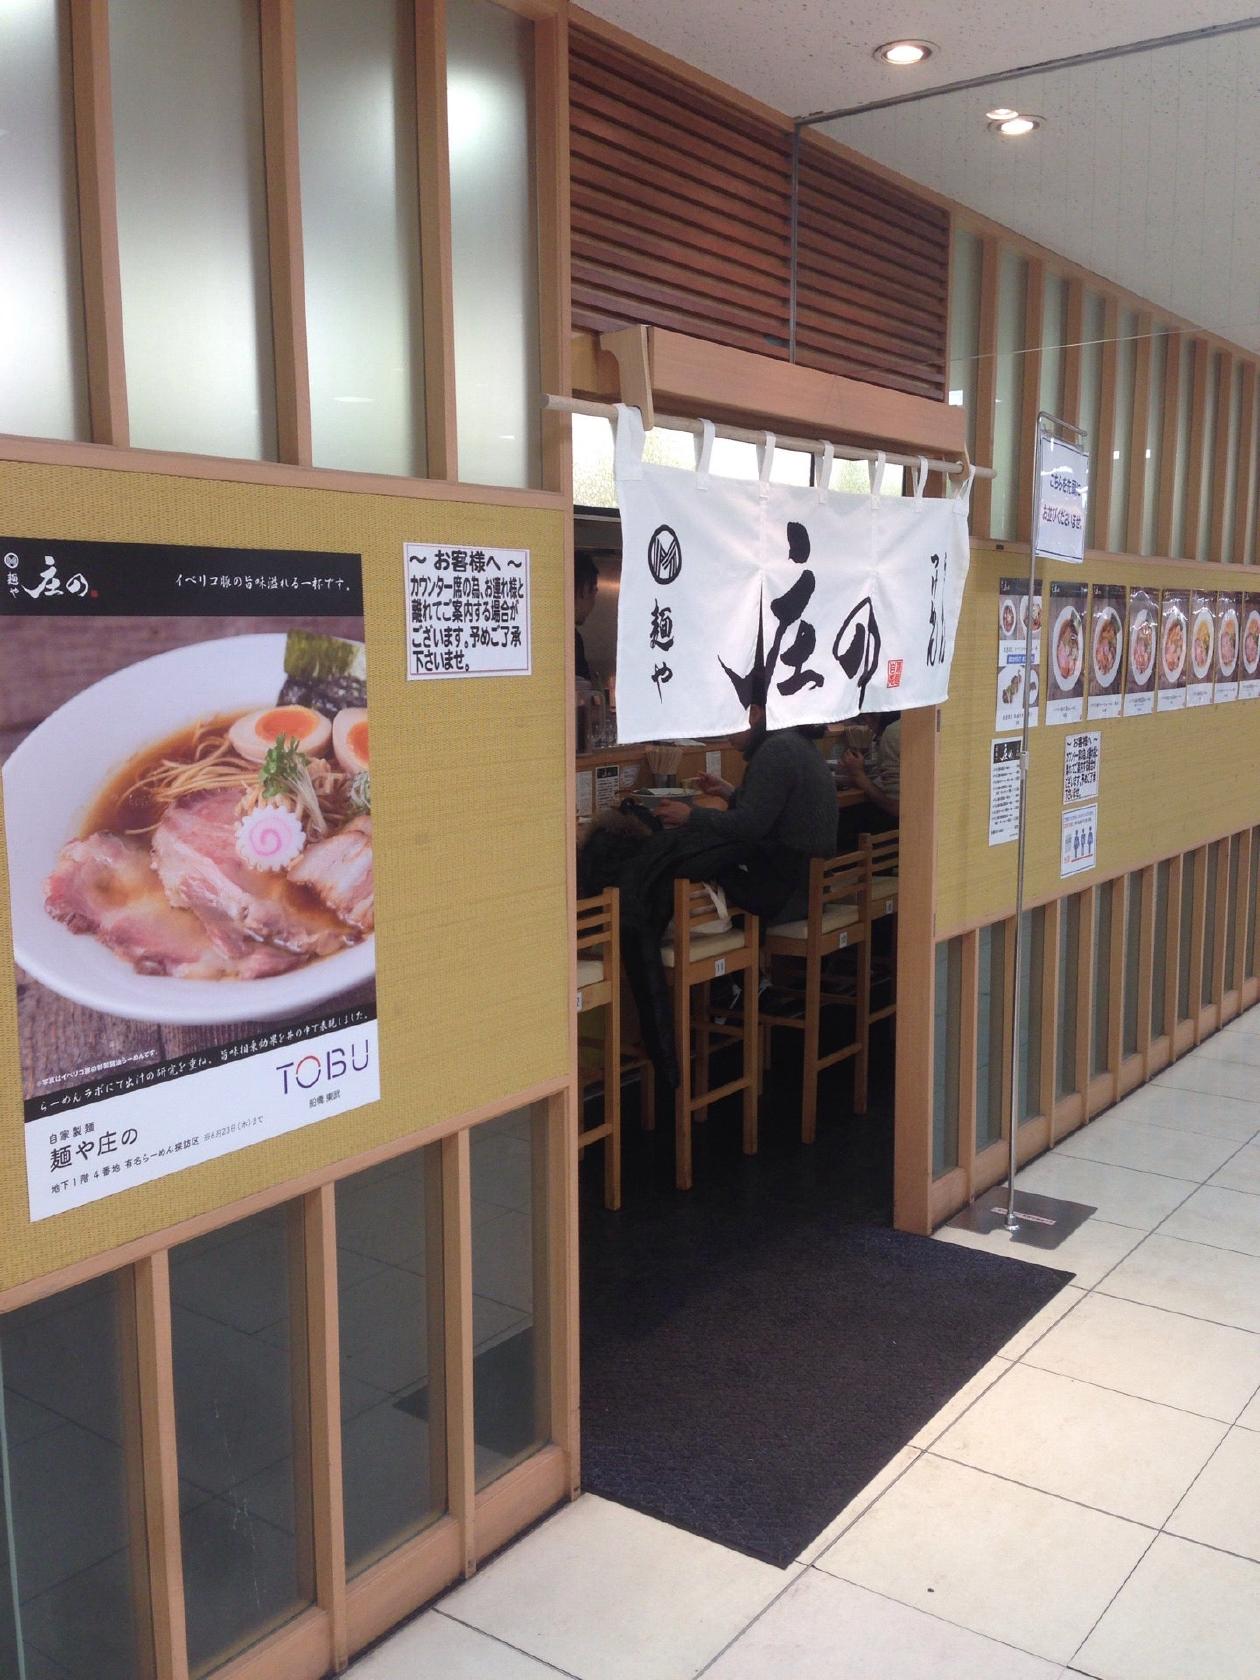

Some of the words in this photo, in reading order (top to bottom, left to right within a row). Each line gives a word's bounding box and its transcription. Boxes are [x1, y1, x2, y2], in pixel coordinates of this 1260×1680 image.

[21, 555, 89, 599] 庄の
[410, 575, 524, 600] カウンター席の為、お連れ様と
[411, 598, 519, 623] 離れてご案内する場合が
[412, 624, 522, 649] ございます。予めご了承
[412, 649, 470, 673] 下さいませ。
[649, 598, 674, 704] 麺や
[276, 1039, 369, 1095] TOBU
[50, 1121, 95, 1145] 自家製麺
[50, 1127, 138, 1173] 麺や庄の
